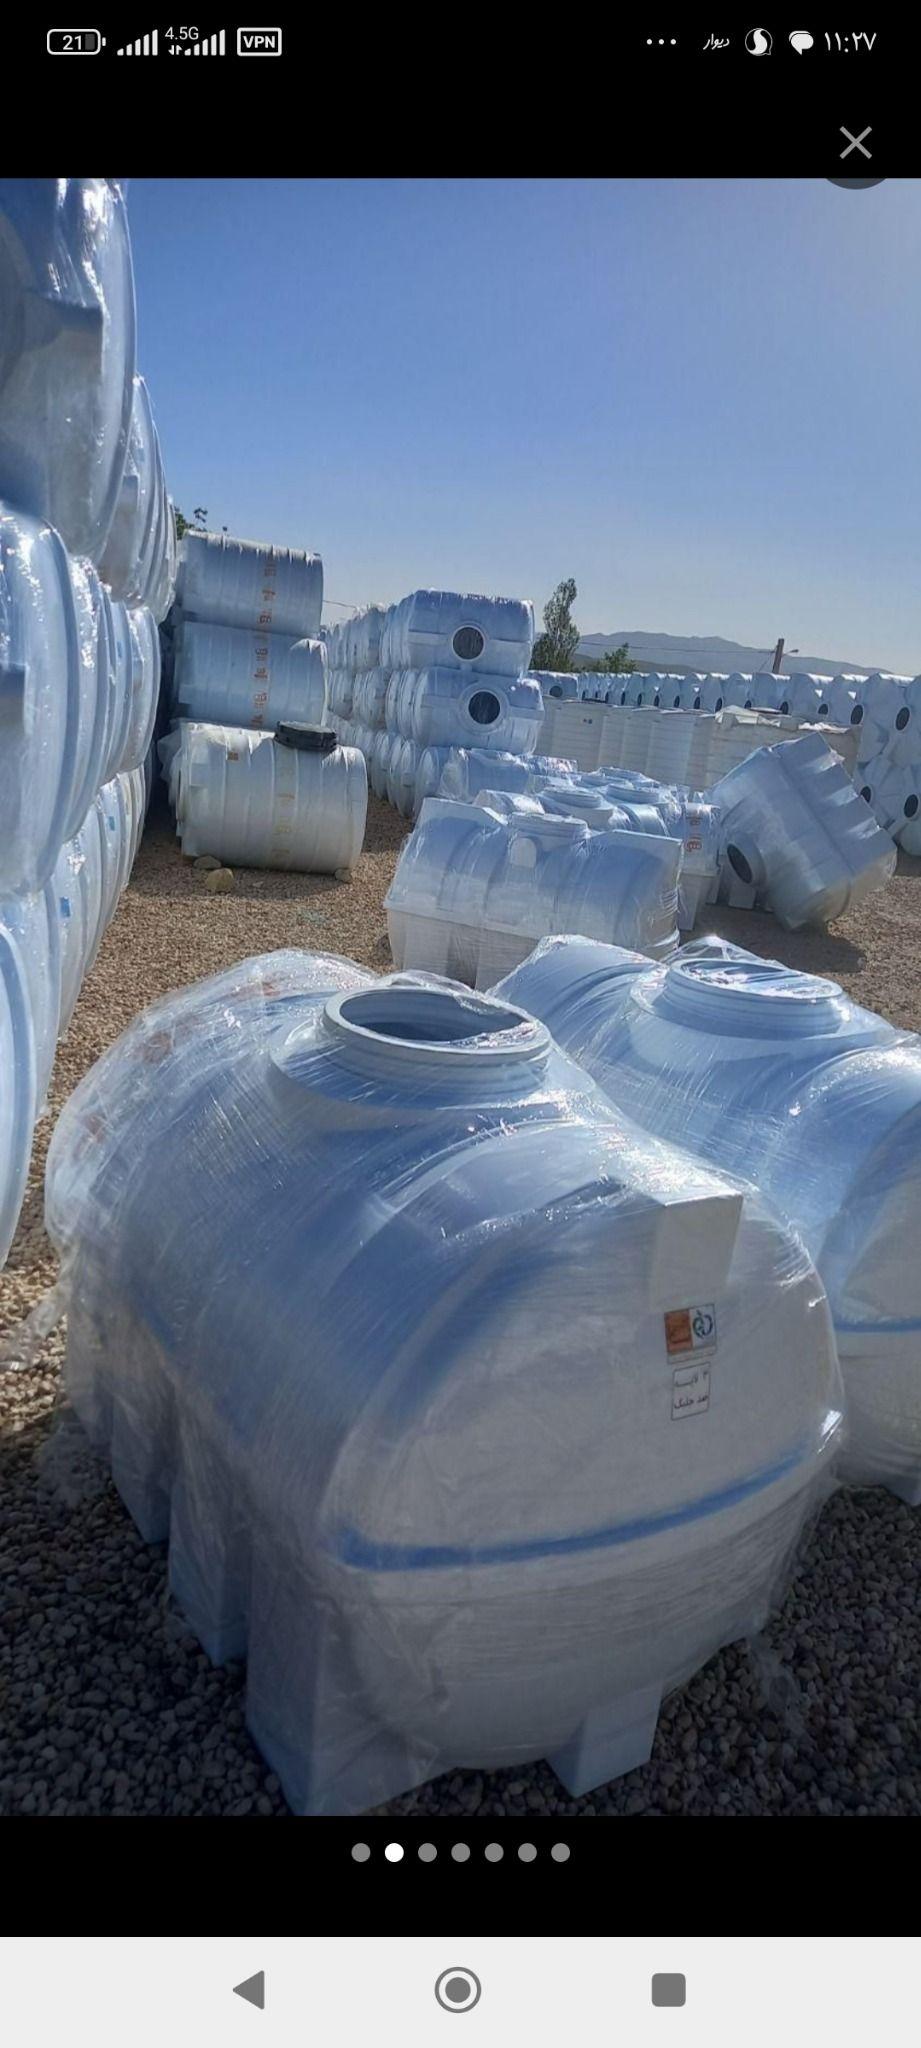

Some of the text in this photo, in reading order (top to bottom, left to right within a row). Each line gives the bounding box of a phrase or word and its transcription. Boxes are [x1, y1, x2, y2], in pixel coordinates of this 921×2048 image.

[164, 26, 199, 40] 4.5G
[63, 35, 82, 50] 21
[243, 36, 276, 48] VPN
[703, 33, 730, 50] دیوار
[825, 32, 877, 53] ۱۱:۲۷
